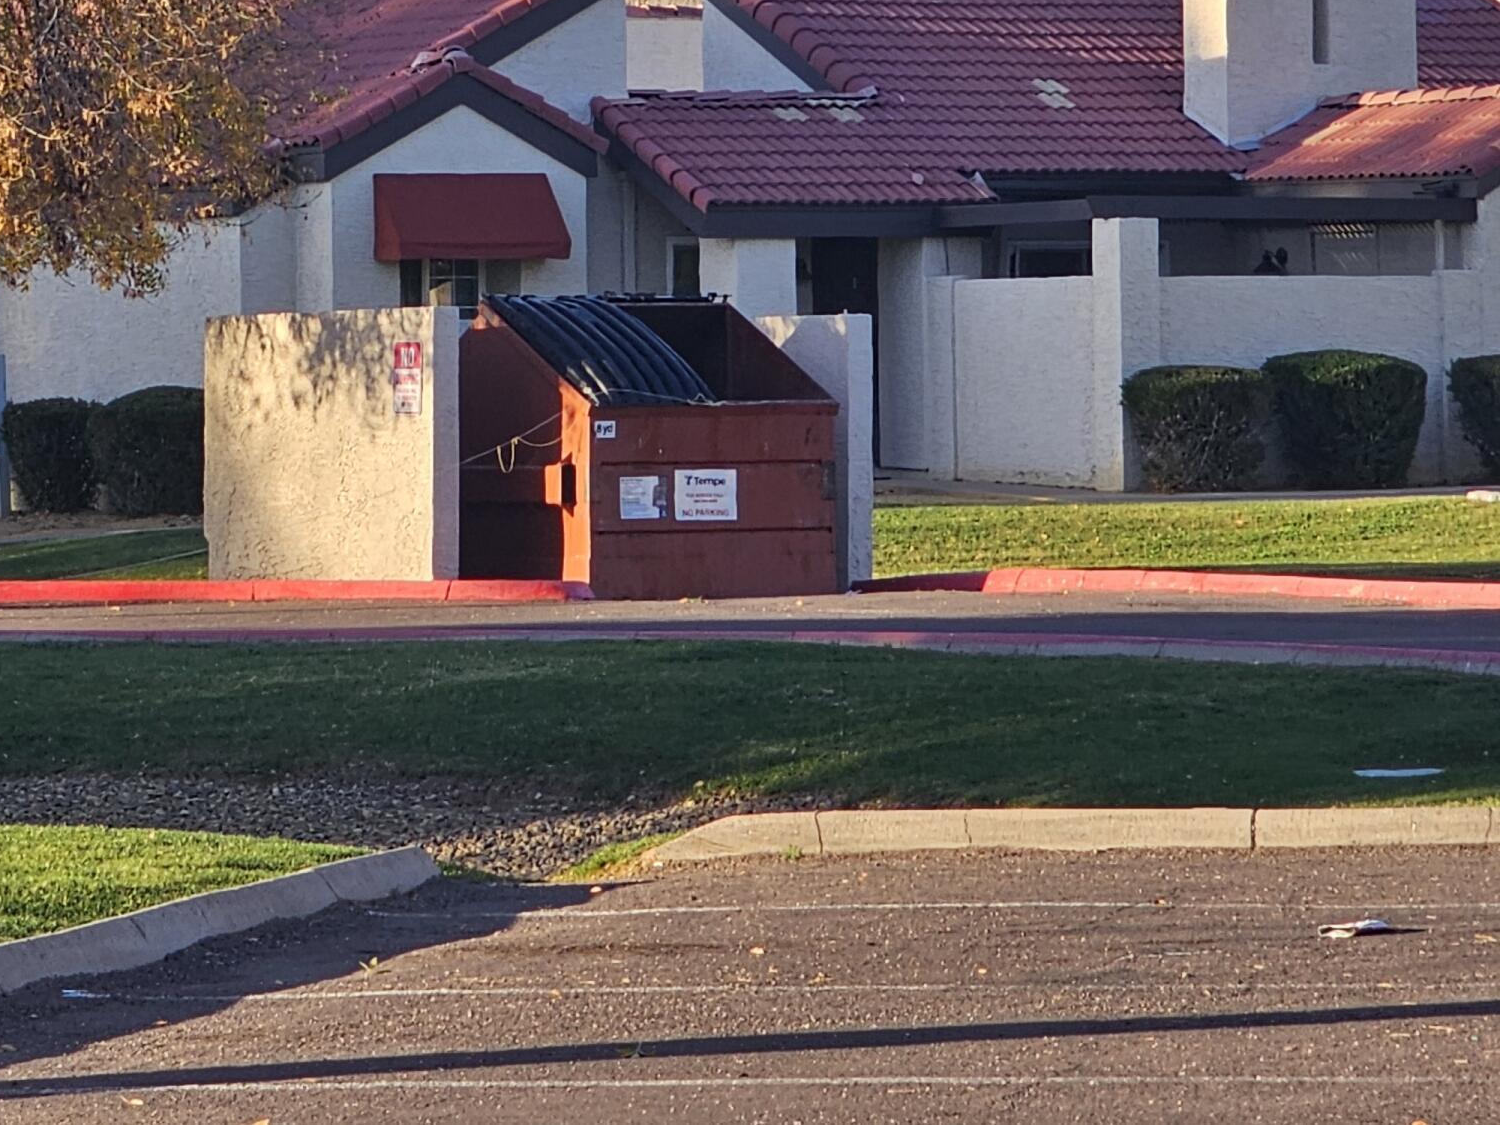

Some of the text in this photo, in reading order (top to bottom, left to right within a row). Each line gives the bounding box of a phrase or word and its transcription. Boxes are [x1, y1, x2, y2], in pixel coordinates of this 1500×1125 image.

[400, 346, 415, 368] NO
[694, 476, 726, 487] Tempe
[682, 507, 730, 517] NO PARKING
